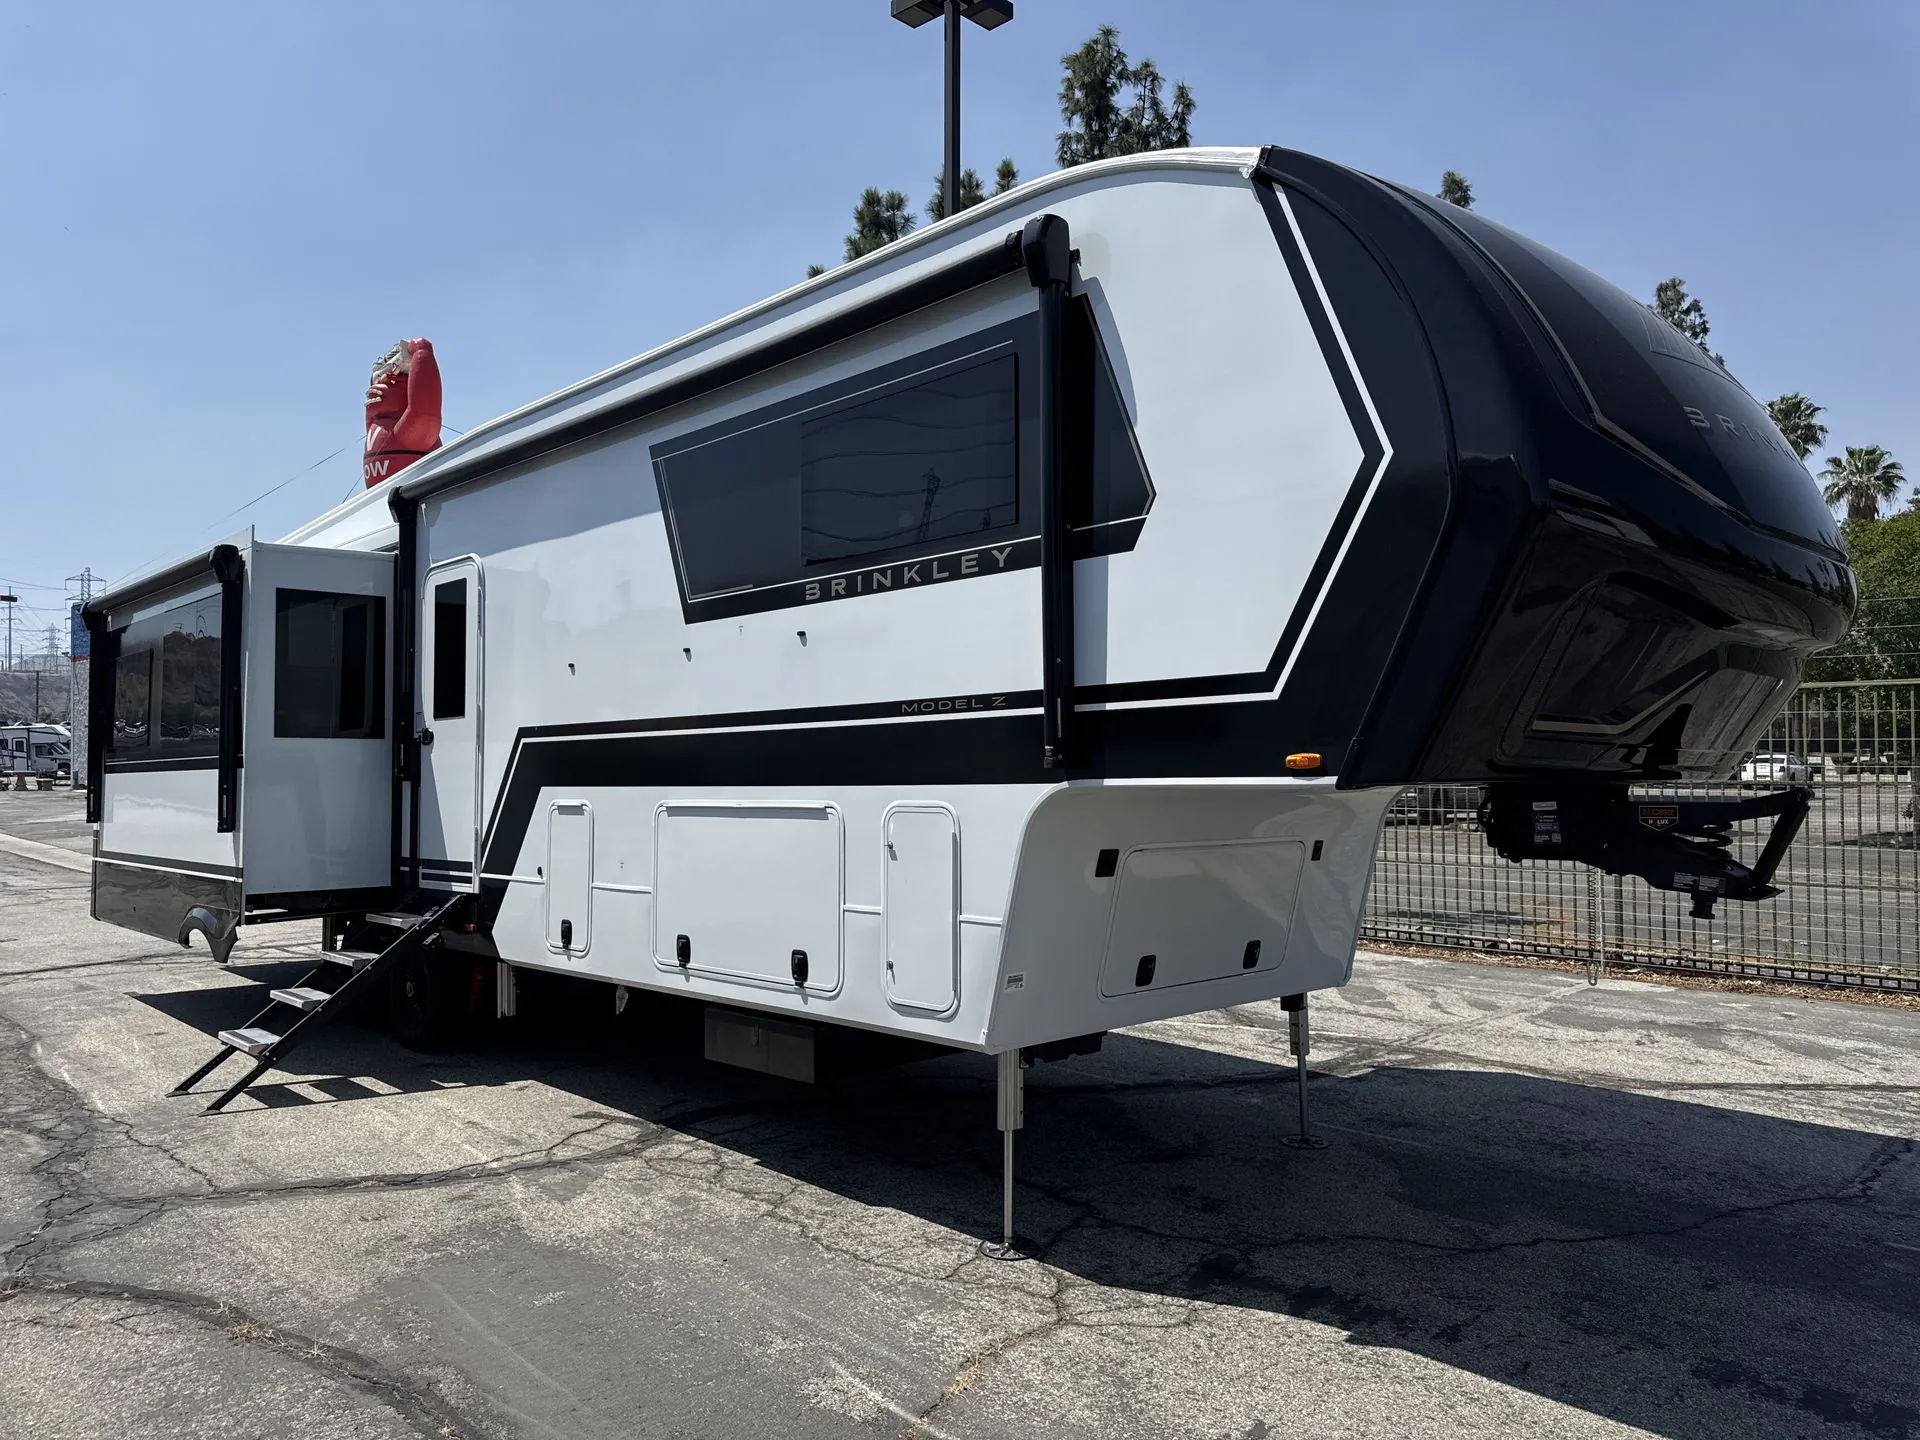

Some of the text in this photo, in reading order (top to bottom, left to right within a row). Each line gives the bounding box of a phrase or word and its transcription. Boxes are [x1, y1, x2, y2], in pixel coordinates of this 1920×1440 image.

[804, 546, 1013, 601] BRINKLEY
[901, 695, 1007, 714] MODEL Z
